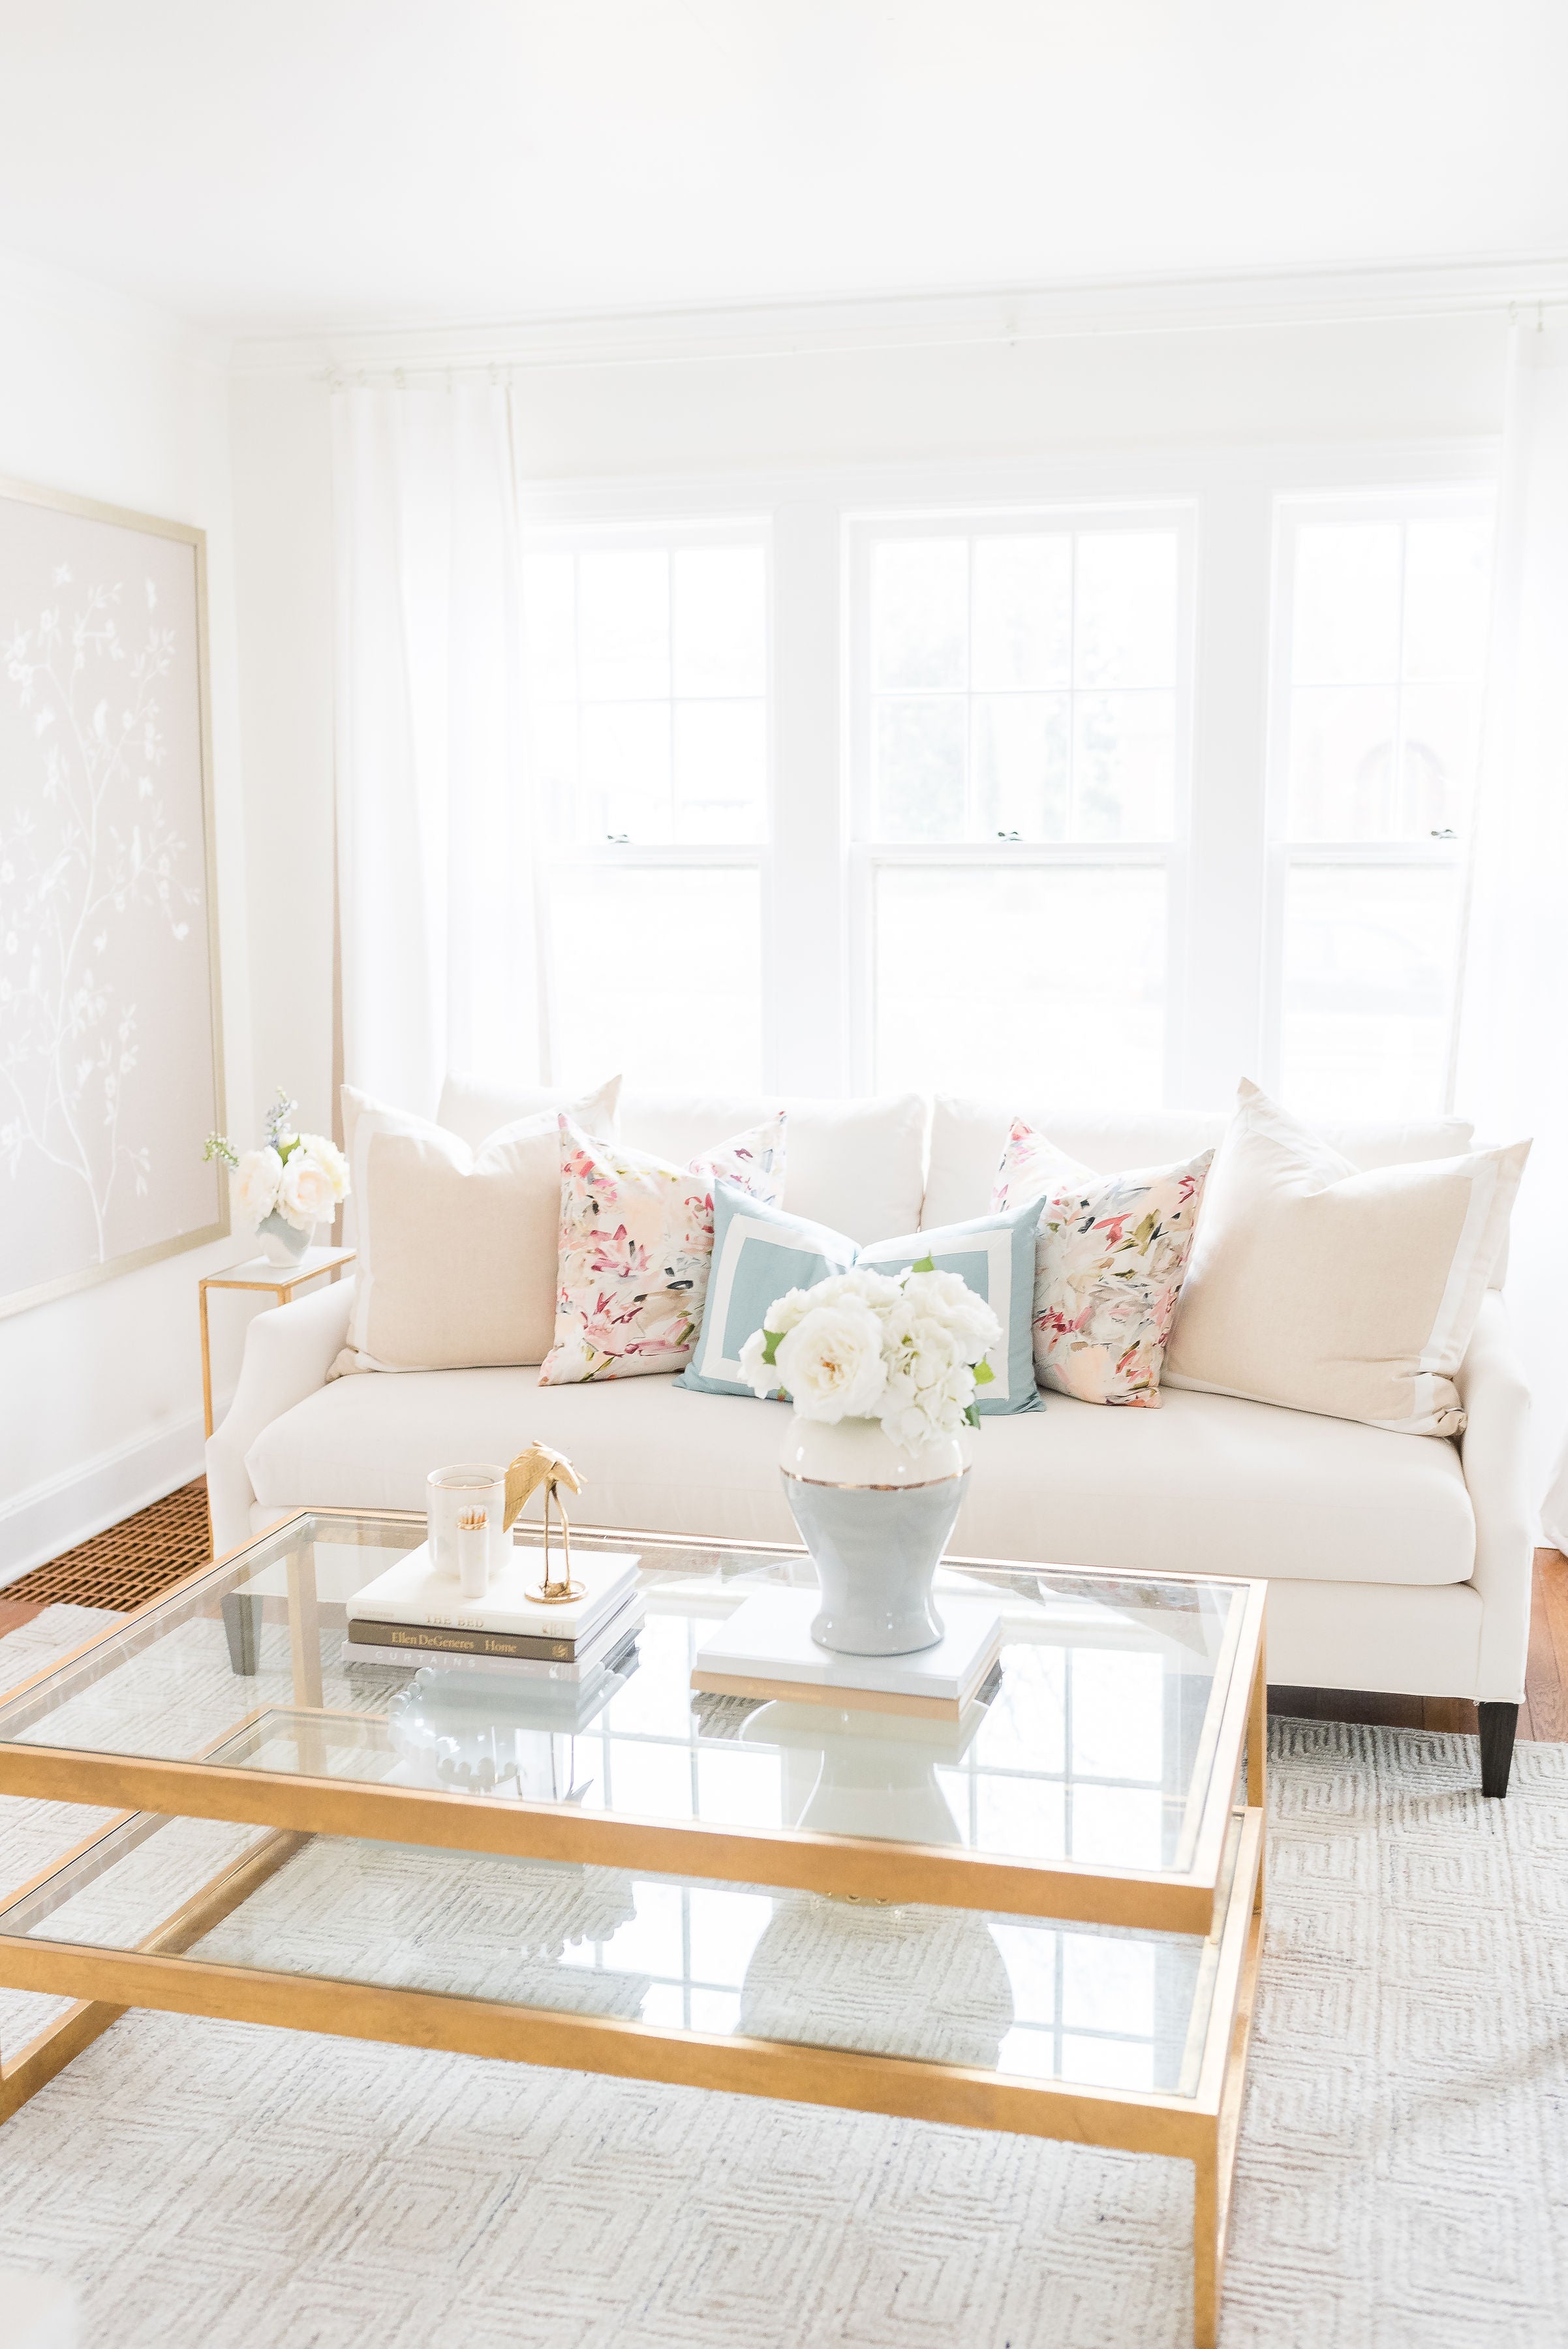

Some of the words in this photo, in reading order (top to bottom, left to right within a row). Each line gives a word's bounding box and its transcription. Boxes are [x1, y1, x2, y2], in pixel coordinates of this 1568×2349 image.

[425, 1613, 452, 1625] THE
[457, 1616, 485, 1629] BED
[392, 1632, 417, 1644] Ellen
[418, 1634, 474, 1650] DeGeneres
[485, 1640, 517, 1653] Home
[375, 1651, 476, 1668] CURTAINS
